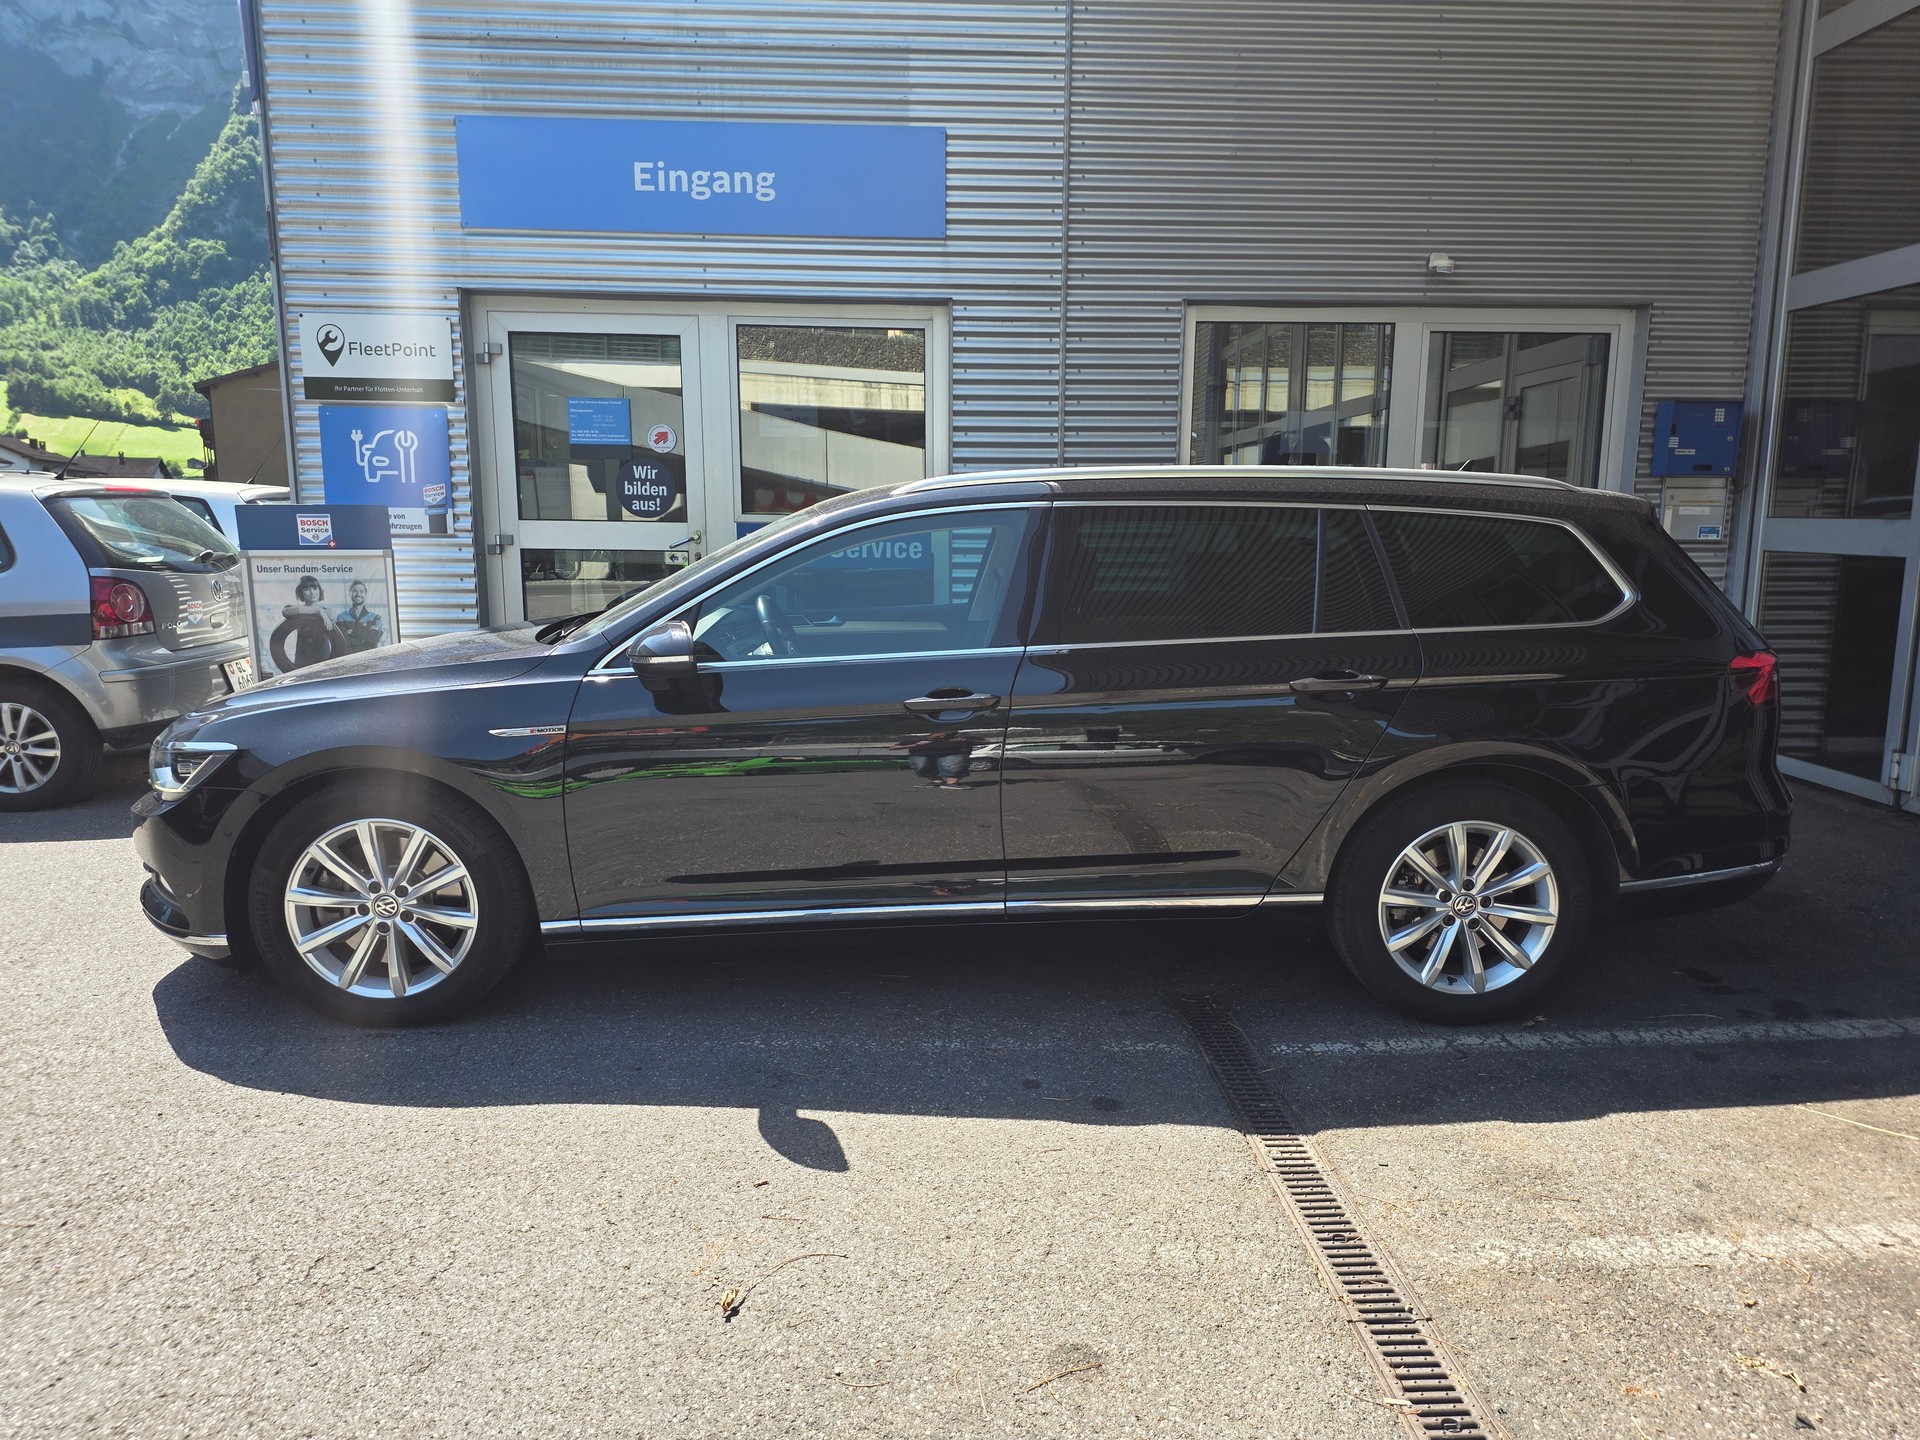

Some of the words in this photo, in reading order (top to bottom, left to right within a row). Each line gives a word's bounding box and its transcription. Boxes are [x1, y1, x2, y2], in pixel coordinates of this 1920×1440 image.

[633, 161, 776, 201] Eingang
[348, 341, 436, 357] FleetPoint
[632, 465, 658, 479] Wir
[424, 485, 445, 493] BOSCH
[624, 481, 667, 496] bilden
[631, 498, 660, 511] aus!
[300, 519, 329, 527] BOSCH
[256, 565, 281, 573] Unser
[284, 565, 354, 573] Rundum-Service
[161, 621, 181, 630] POLO
[235, 661, 246, 673] GL
